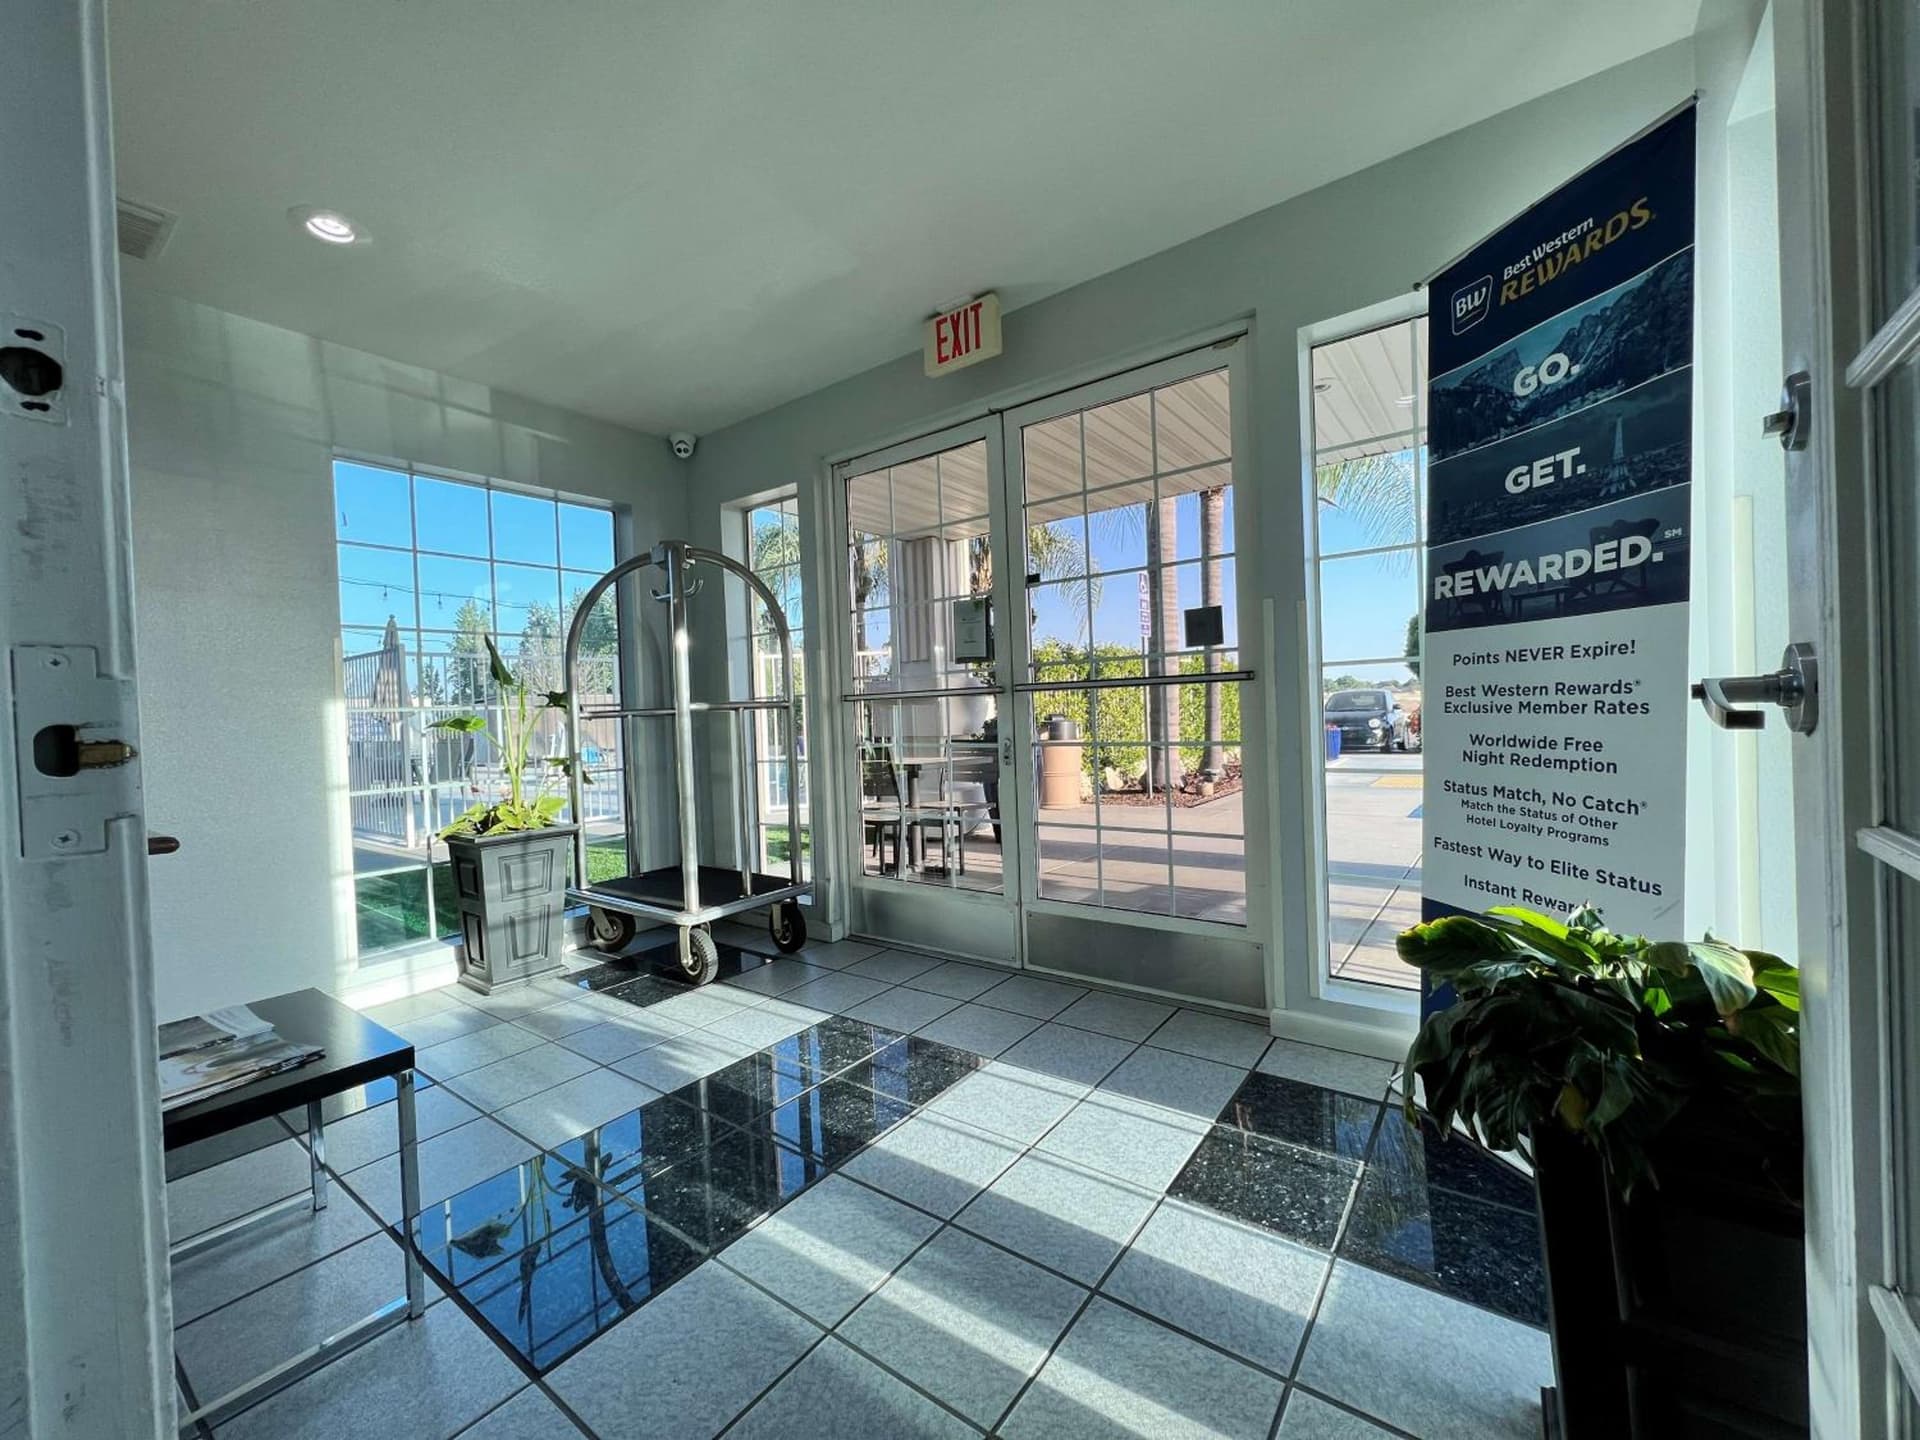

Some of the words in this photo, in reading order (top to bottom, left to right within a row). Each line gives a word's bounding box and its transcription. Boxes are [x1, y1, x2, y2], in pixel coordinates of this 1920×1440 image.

[1503, 255, 1532, 281] Best
[1532, 217, 1594, 262] Western
[1456, 287, 1487, 318] BW
[936, 302, 982, 364] EXIT
[1513, 352, 1580, 396] GO.
[1505, 447, 1586, 494] GET.
[1434, 535, 1664, 600] REWARDED.
[1453, 651, 1500, 666] Points
[1505, 646, 1564, 663] NEVER
[1571, 639, 1636, 660] Expire!
[1446, 685, 1476, 698] Best
[1482, 683, 1549, 697] Western
[1444, 701, 1512, 714] Exclusive
[1518, 701, 1588, 714] Member
[1594, 701, 1650, 715] Rates
[1469, 733, 1558, 750] Worldwide
[1564, 737, 1603, 752] Free
[1462, 750, 1505, 766] Night
[1510, 752, 1618, 774] Redemption
[1443, 779, 1488, 797] Status
[1493, 785, 1546, 806] Match,
[1552, 792, 1577, 808] No
[1461, 799, 1494, 812] Match
[1497, 803, 1516, 815] the
[1520, 807, 1557, 821] Status
[1561, 812, 1575, 824] of
[1579, 815, 1618, 831] Other
[1466, 814, 1496, 827] Hotel
[1500, 819, 1543, 836] Loyalty
[1547, 827, 1609, 846] Programs
[1434, 836, 1483, 858] Fastest
[1488, 848, 1522, 868] Way
[1528, 855, 1545, 871] to
[1551, 860, 1590, 880] Elite
[1596, 869, 1662, 896] Status
[1464, 874, 1517, 899] Instant
